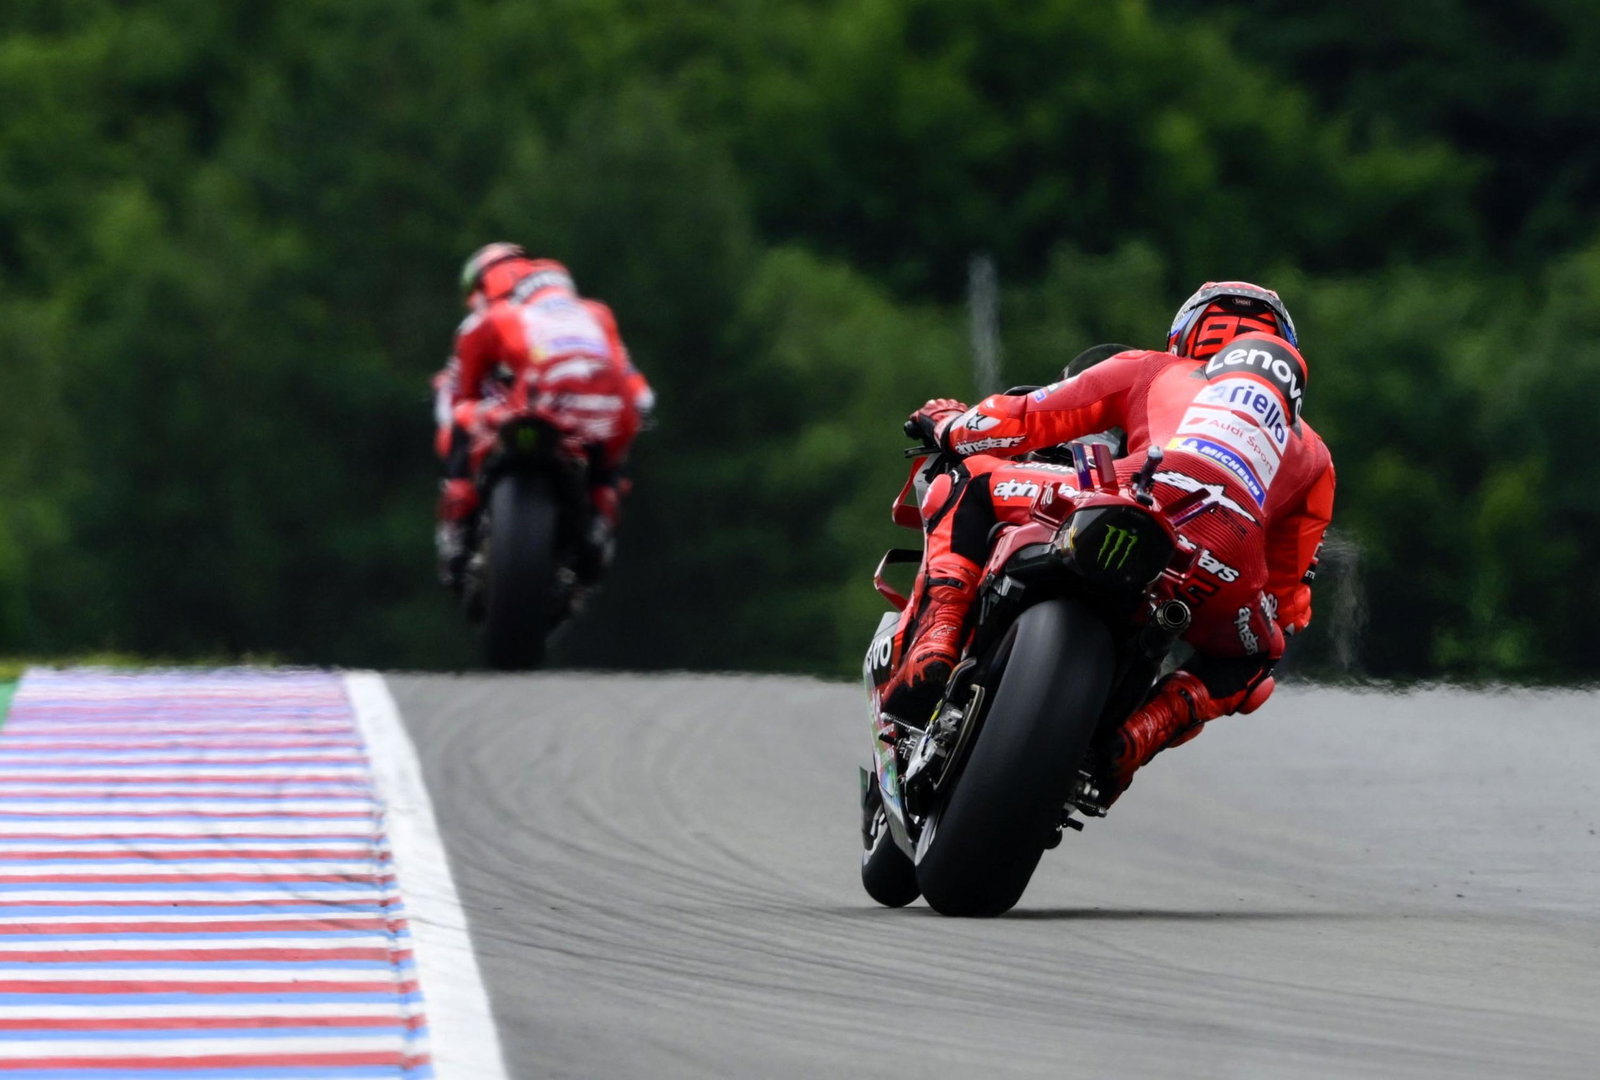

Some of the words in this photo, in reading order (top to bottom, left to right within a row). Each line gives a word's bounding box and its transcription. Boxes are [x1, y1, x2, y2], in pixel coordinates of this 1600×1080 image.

[1200, 446, 1261, 496] MICHELIN
[1207, 419, 1244, 438] Audi
[1246, 435, 1273, 475] Sport
